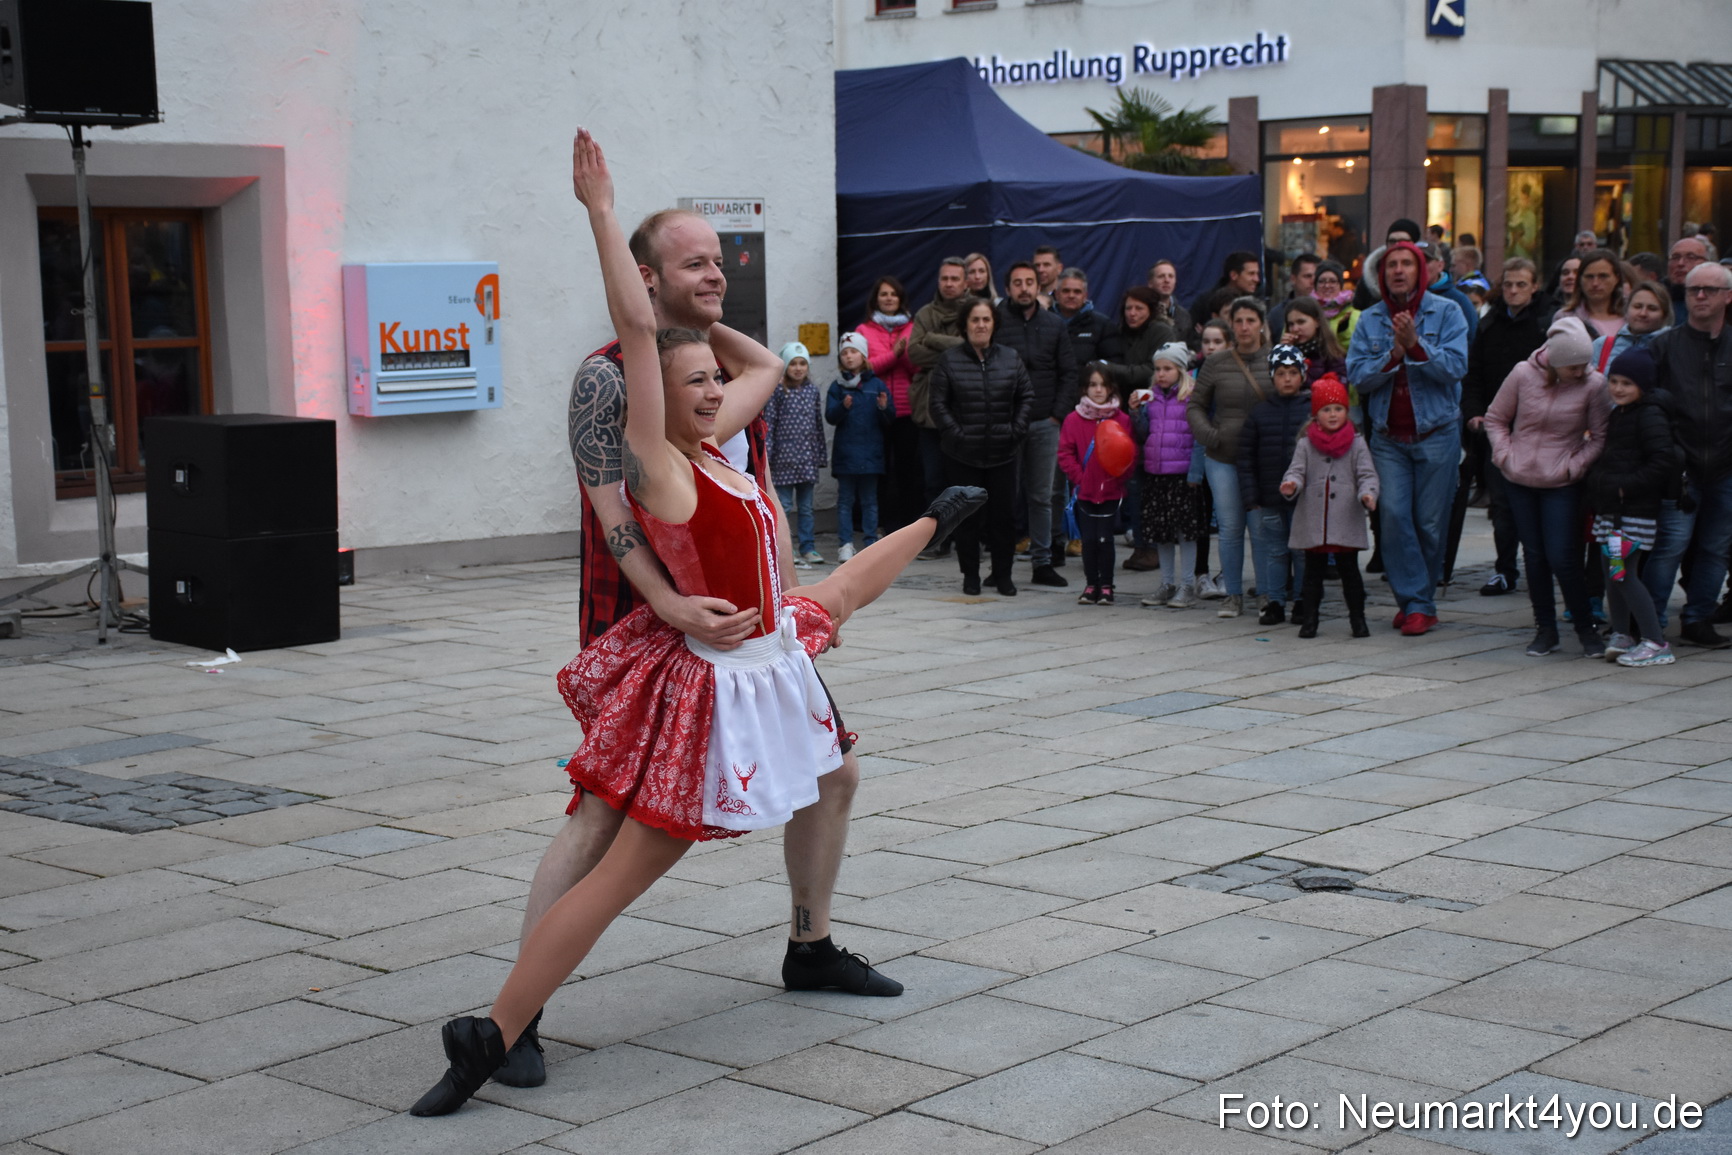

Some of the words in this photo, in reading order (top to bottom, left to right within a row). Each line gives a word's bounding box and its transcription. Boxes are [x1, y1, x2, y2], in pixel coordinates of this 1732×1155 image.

[1133, 32, 1287, 79] Rupprecht
[695, 202, 752, 215] NEUMARKT
[379, 321, 471, 353] Kunst
